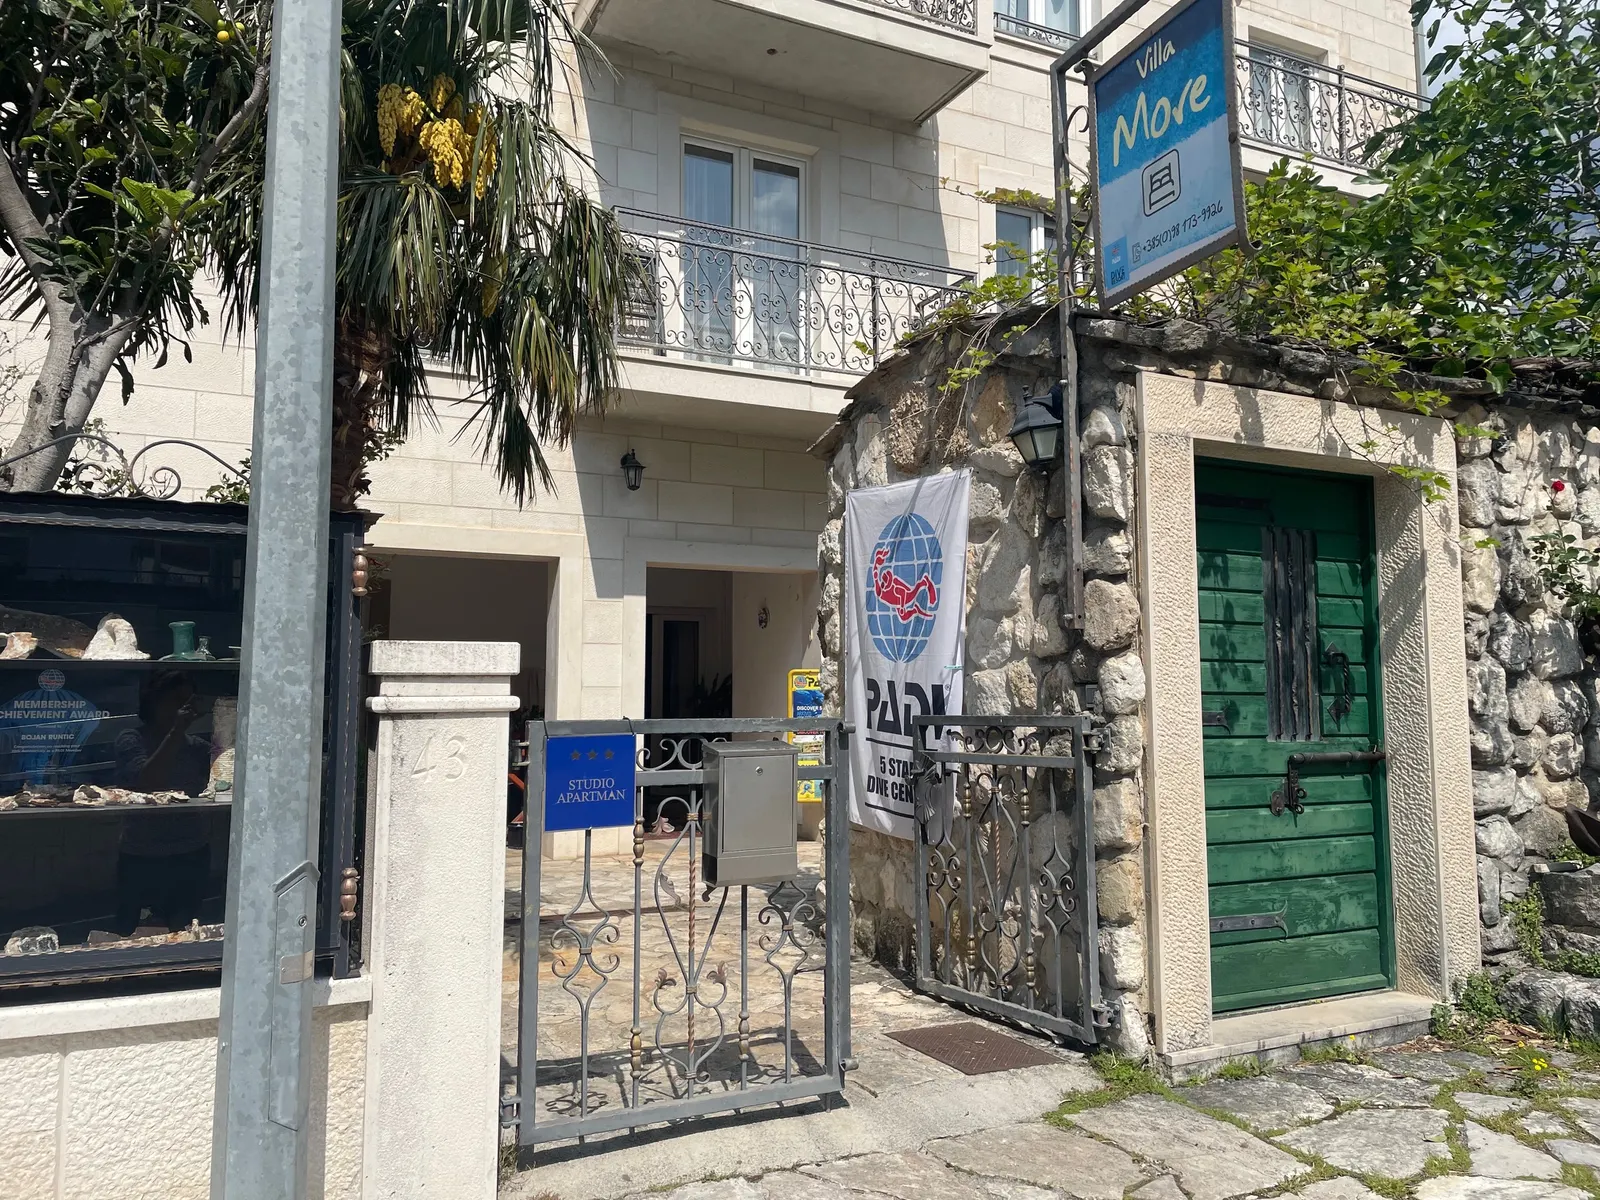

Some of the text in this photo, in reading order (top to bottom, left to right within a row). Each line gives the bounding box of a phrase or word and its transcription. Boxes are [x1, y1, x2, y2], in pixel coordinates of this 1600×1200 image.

[1136, 38, 1176, 79] Villa
[1113, 74, 1211, 168] More
[14, 700, 86, 709] MEMBERSHIP
[69, 710, 110, 719] AWARD
[867, 677, 947, 741] PADI
[410, 728, 467, 783] 43
[880, 755, 886, 774] 5
[568, 777, 615, 791] STUDIO
[891, 781, 914, 804] CEN
[556, 788, 626, 804] APARTMAN
